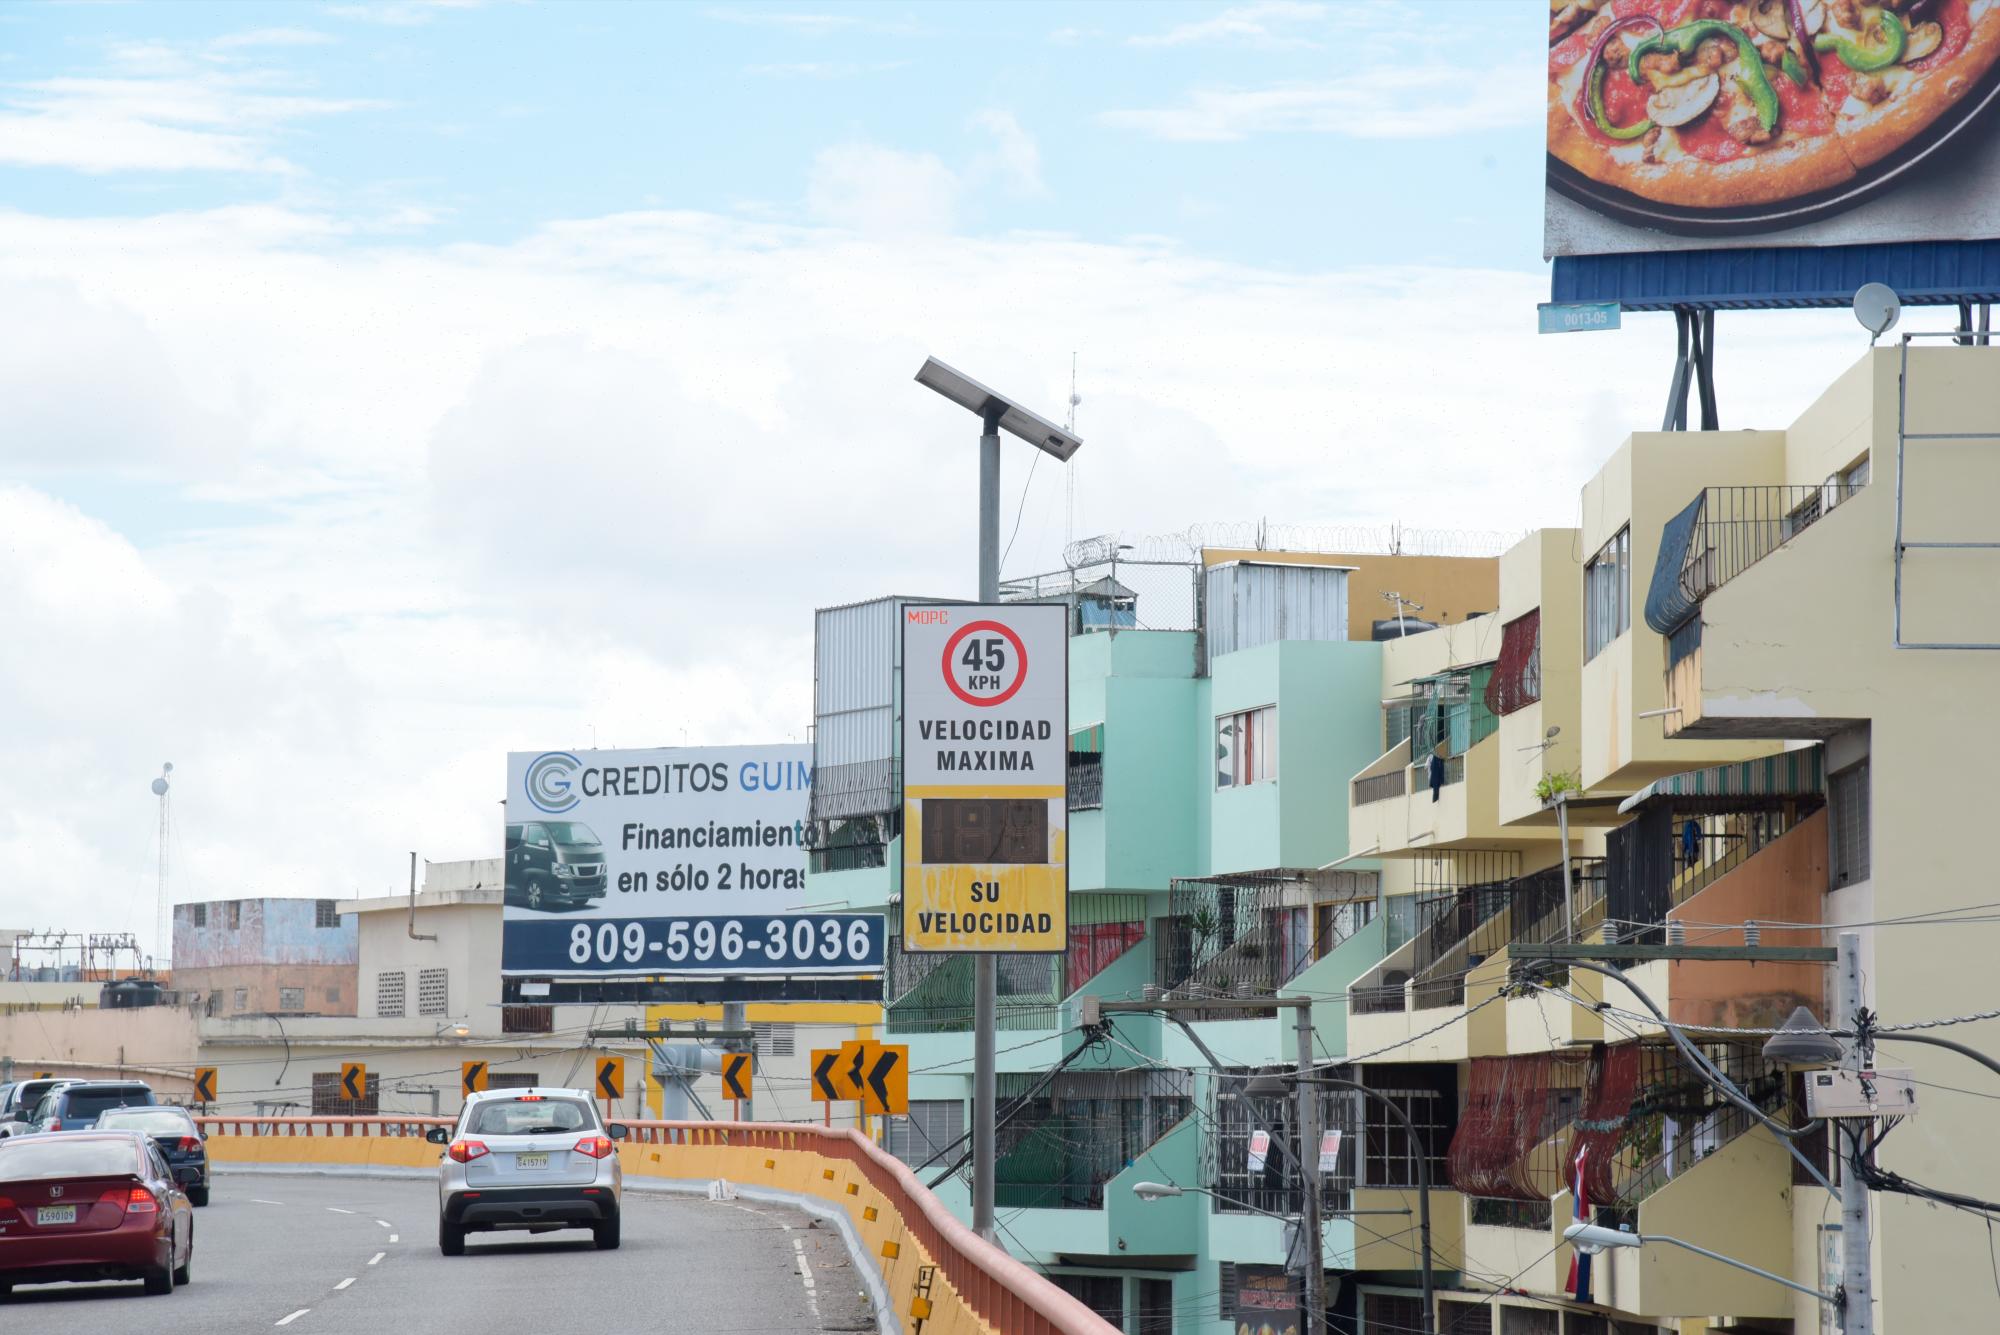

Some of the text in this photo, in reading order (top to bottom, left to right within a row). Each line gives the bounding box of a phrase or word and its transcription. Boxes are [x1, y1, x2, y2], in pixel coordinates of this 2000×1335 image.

[1565, 311, 1607, 325] 0013-05
[908, 610, 948, 625] MOPC
[962, 638, 1005, 672] 45
[968, 676, 1001, 690] KPH
[919, 719, 1051, 741] VELOCIDAD
[937, 750, 1034, 771] MAXIMA
[582, 762, 728, 797] CREDITOS
[617, 871, 648, 893] en
[656, 863, 709, 892] sólo
[717, 863, 732, 890] 2
[970, 882, 1000, 903] SU
[919, 912, 1052, 934] VELOCIDAD
[569, 919, 871, 964] 809-596-3036
